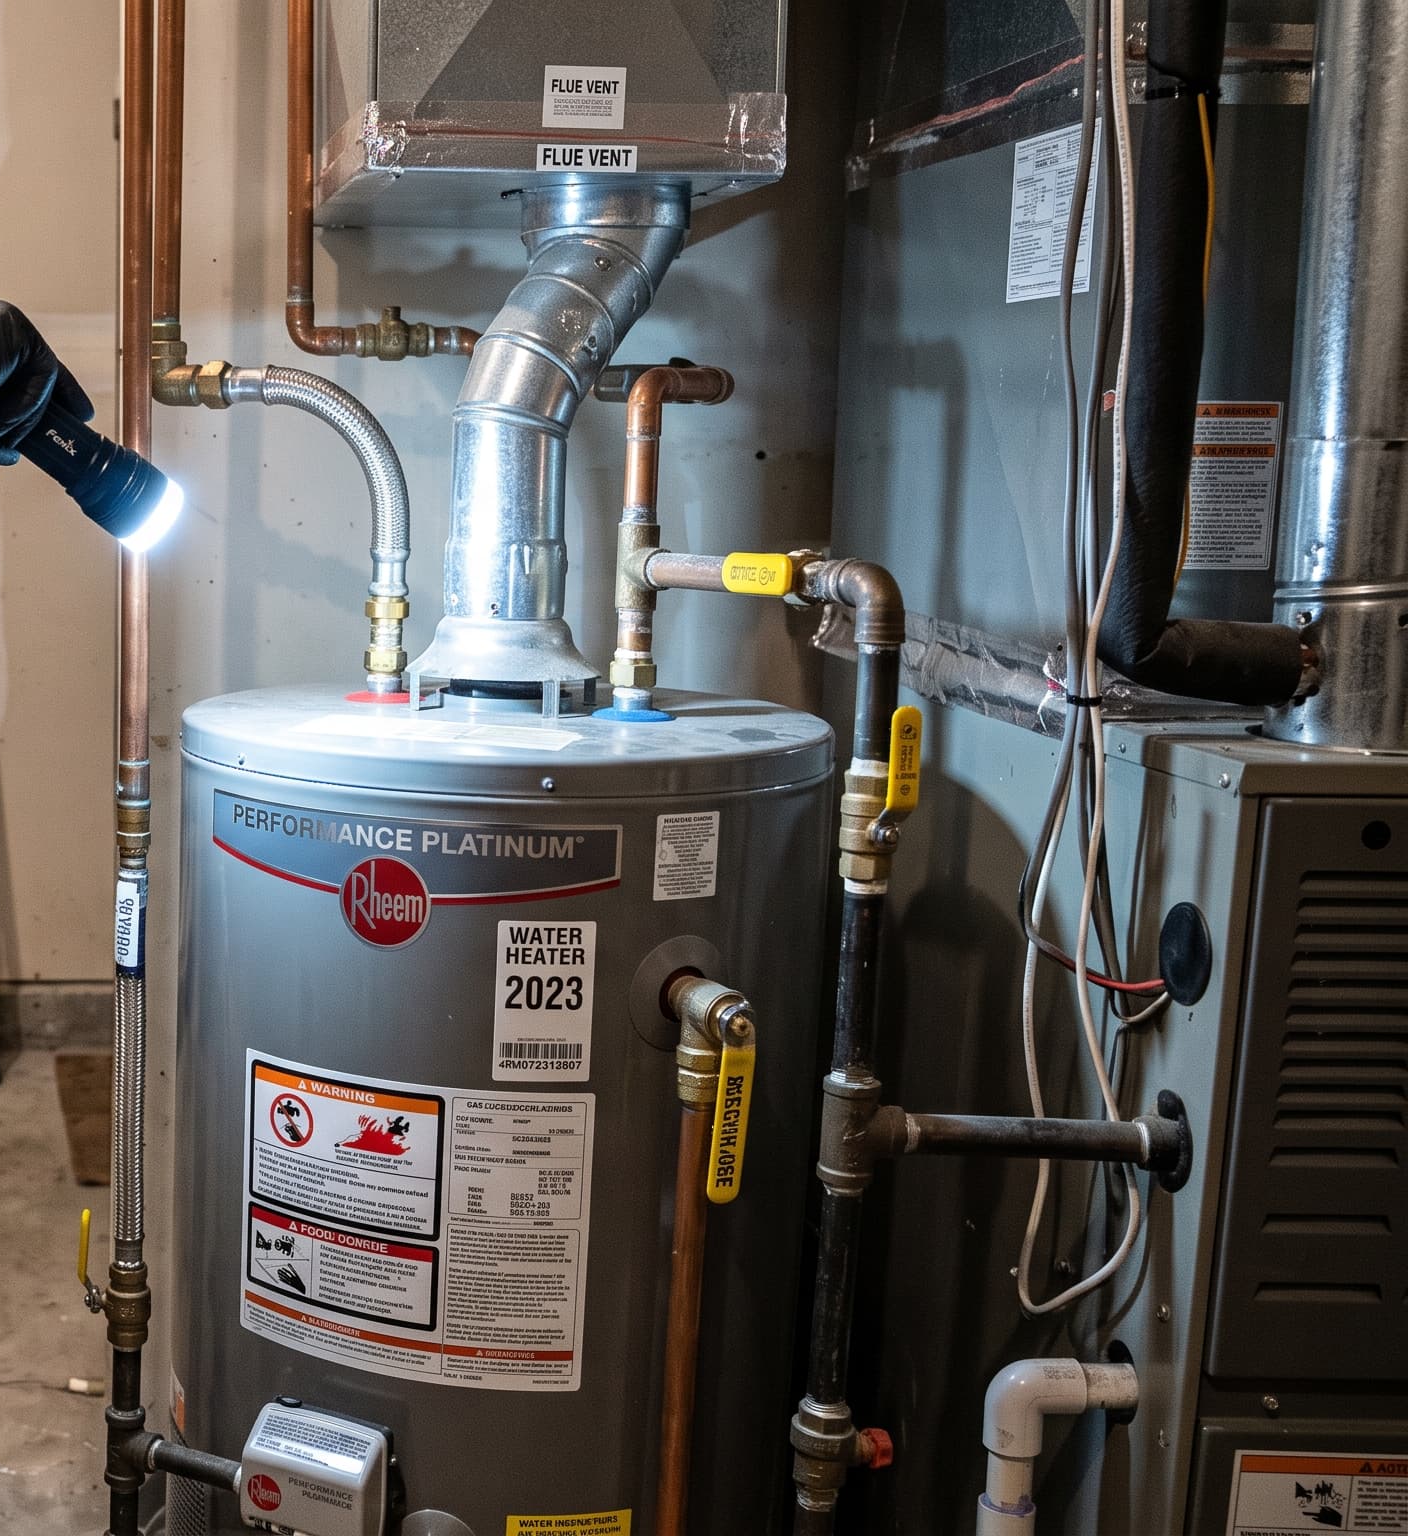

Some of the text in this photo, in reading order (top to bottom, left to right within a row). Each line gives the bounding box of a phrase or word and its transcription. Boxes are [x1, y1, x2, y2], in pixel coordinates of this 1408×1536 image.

[552, 79, 619, 94] FLUE VENT
[543, 148, 632, 166] FLUE VENT
[233, 803, 412, 851] PERFORMANCE
[351, 860, 424, 930] Rheem
[509, 926, 583, 945] WATER
[506, 947, 585, 965] HEATER
[505, 975, 583, 1010] 2023
[310, 1081, 376, 1105] WARNING
[518, 1519, 552, 1528] WATER
